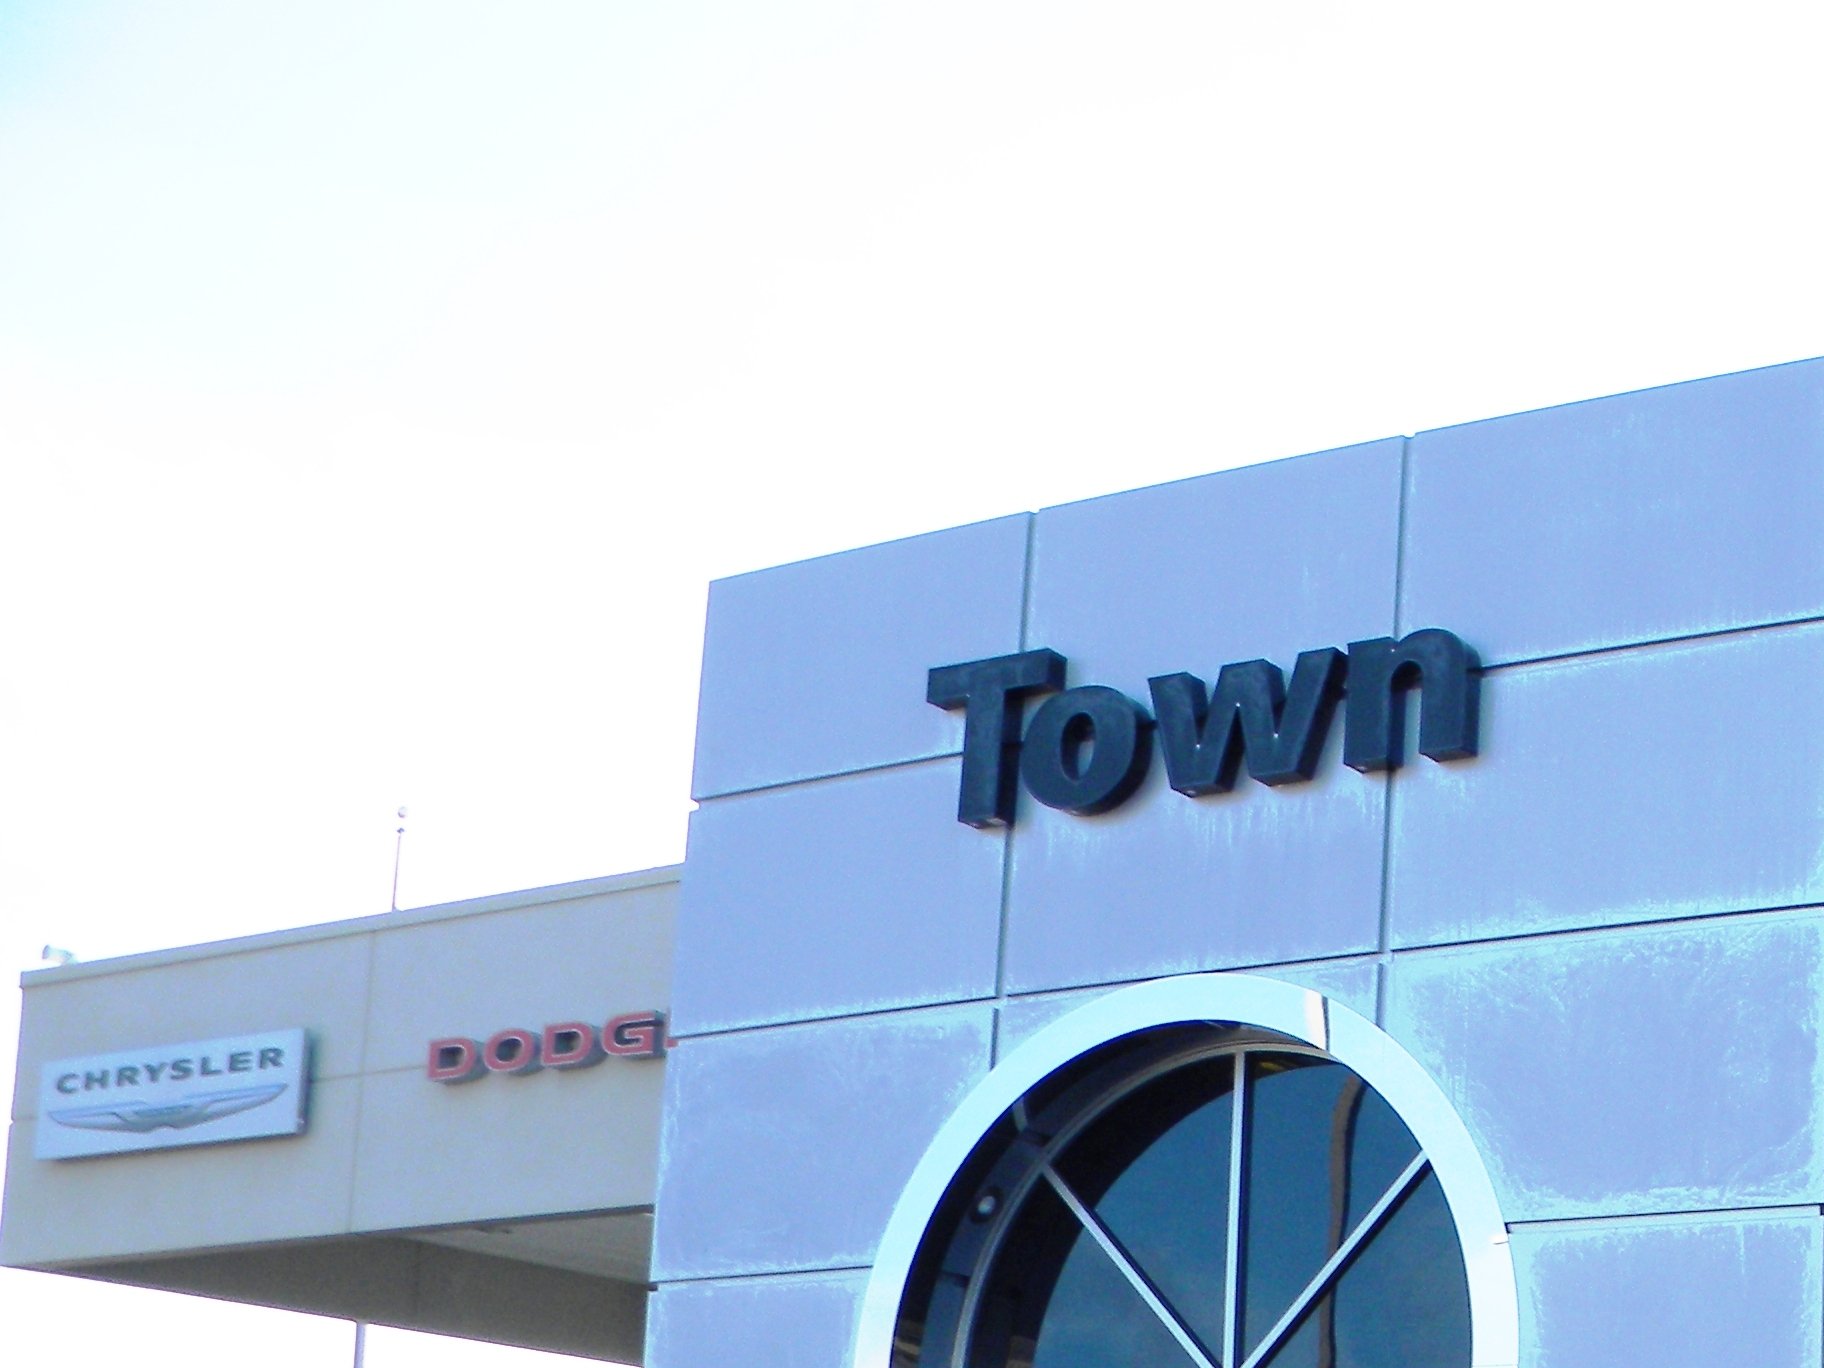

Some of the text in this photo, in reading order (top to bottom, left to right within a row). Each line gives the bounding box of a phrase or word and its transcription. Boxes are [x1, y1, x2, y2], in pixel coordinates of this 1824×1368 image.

[927, 627, 1483, 829] Town
[56, 1046, 285, 1095] CHRYSLER
[425, 1009, 678, 1085] DODG
